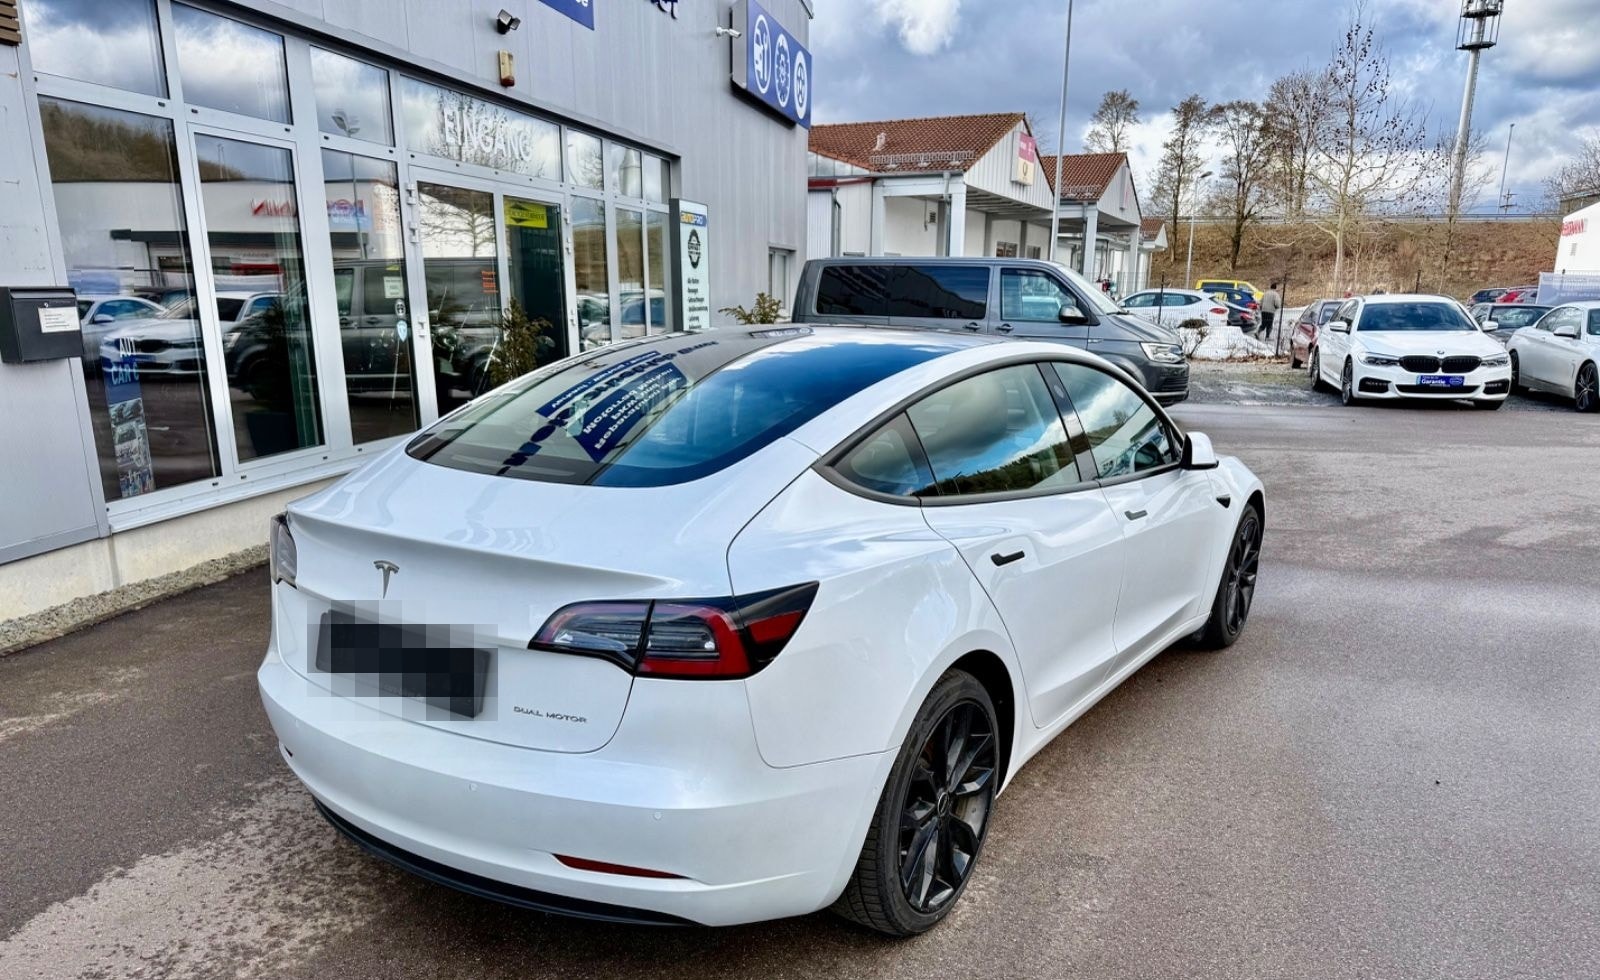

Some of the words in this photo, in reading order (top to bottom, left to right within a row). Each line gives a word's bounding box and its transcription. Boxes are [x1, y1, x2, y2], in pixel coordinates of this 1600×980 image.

[443, 106, 532, 162] EINGANG
[513, 706, 543, 717] DUAL
[546, 712, 588, 723] MOTOR
